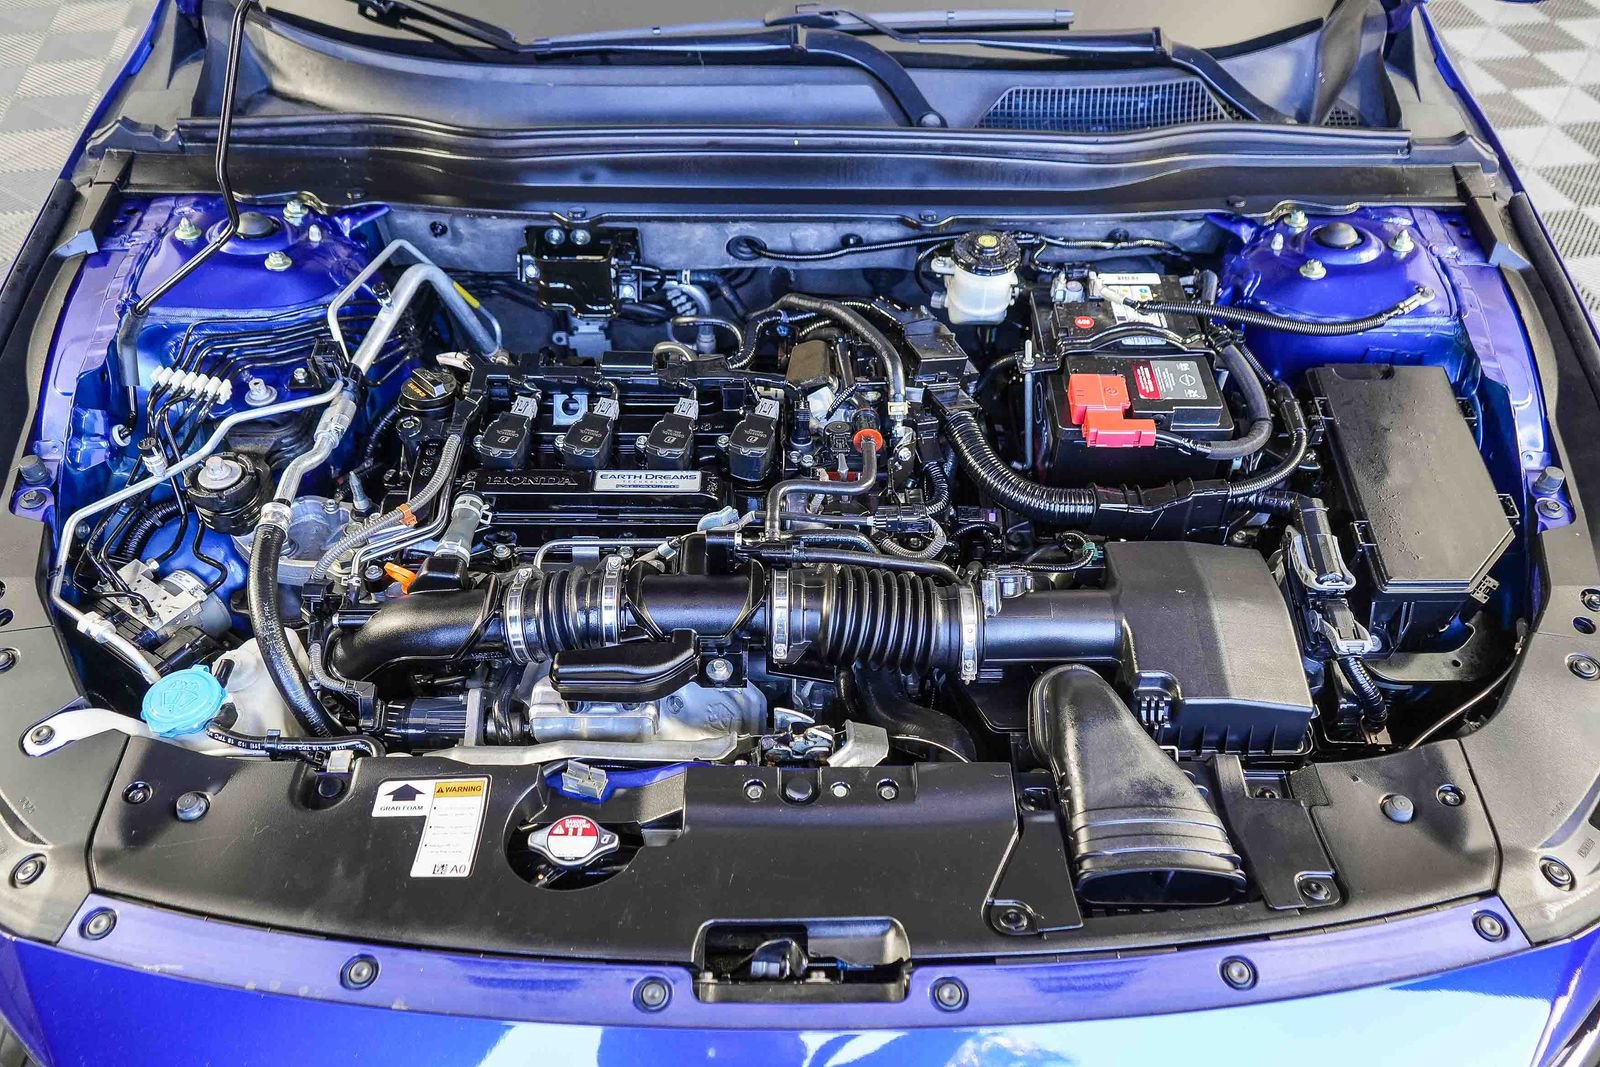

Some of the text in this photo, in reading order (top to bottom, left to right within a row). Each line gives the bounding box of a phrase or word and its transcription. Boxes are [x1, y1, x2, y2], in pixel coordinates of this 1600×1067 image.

[486, 475, 579, 486] HONDA
[645, 473, 698, 481] DREAMS
[445, 784, 482, 794] WARNING
